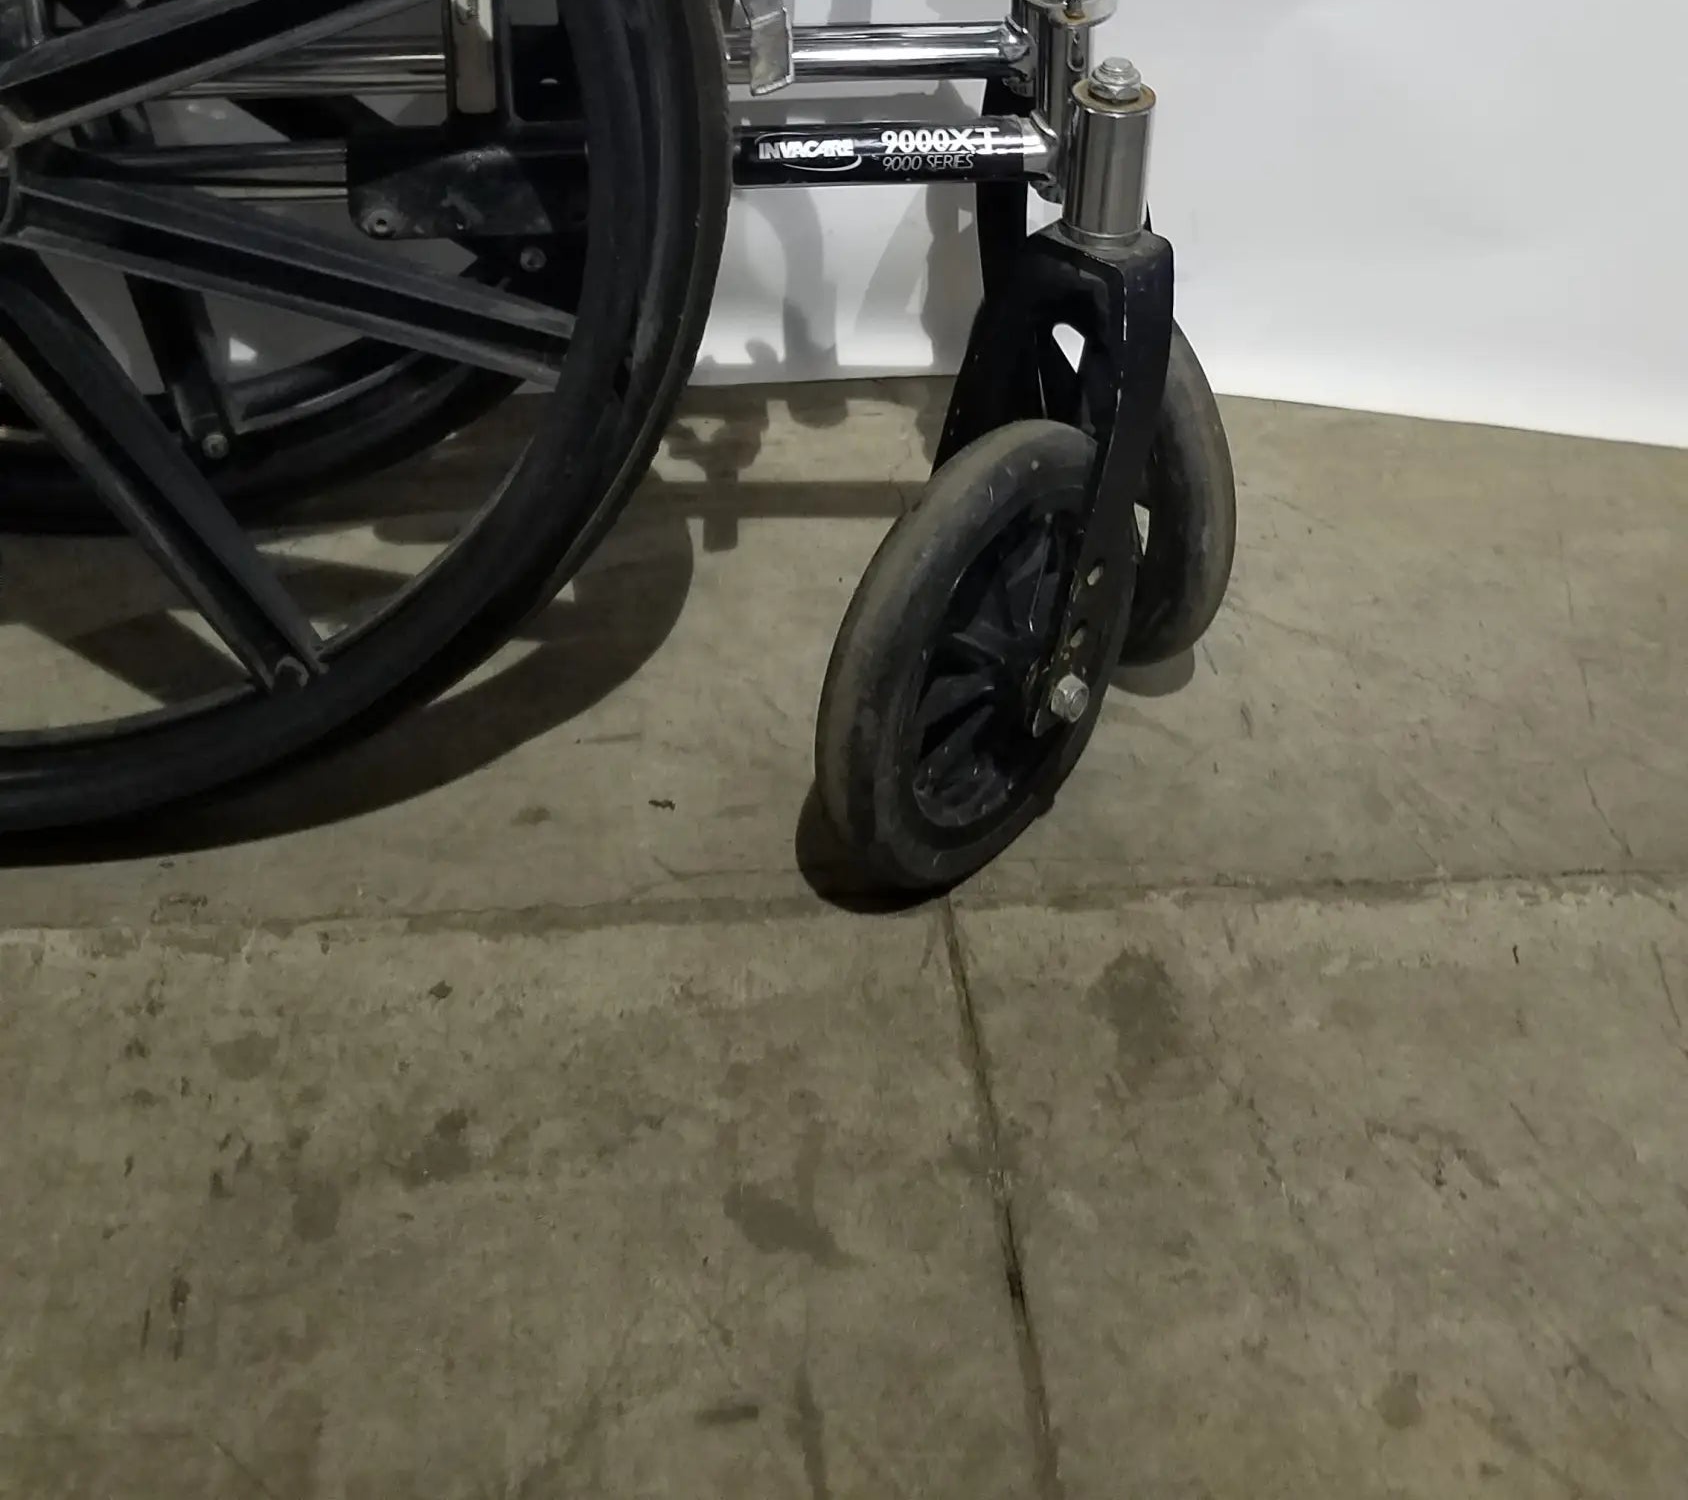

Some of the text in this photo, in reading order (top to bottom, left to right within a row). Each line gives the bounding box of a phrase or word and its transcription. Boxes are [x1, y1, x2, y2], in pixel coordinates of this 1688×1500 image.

[758, 126, 1000, 159] INVACARE 9000XT
[882, 154, 974, 171] 9000 SERIES
